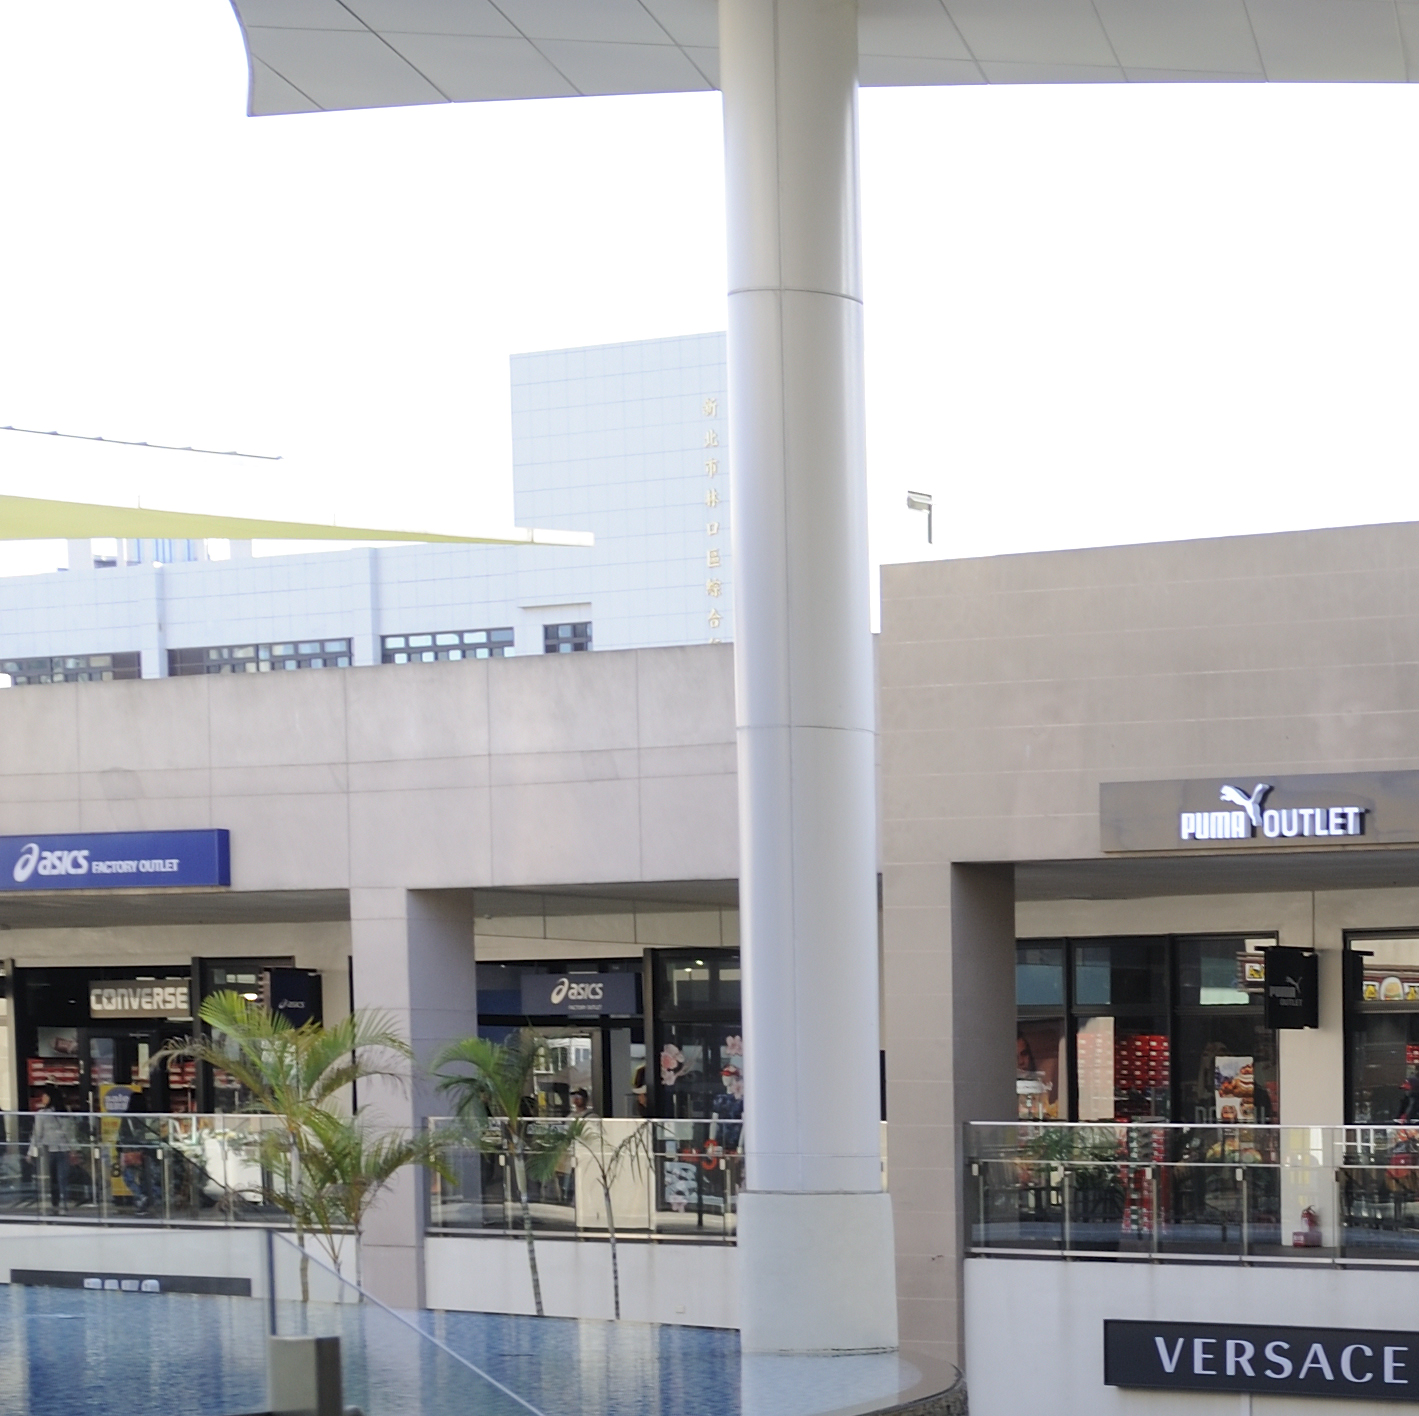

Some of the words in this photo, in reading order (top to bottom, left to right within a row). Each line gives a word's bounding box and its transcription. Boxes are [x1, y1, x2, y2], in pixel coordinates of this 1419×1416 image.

[1180, 811, 1246, 839] PUMA
[1263, 807, 1361, 837] OUTLET
[92, 860, 138, 874] FACTORY
[139, 859, 180, 872] OUTLET
[91, 987, 188, 1011] CONVERSE
[1154, 1336, 1409, 1384] VERSACE
